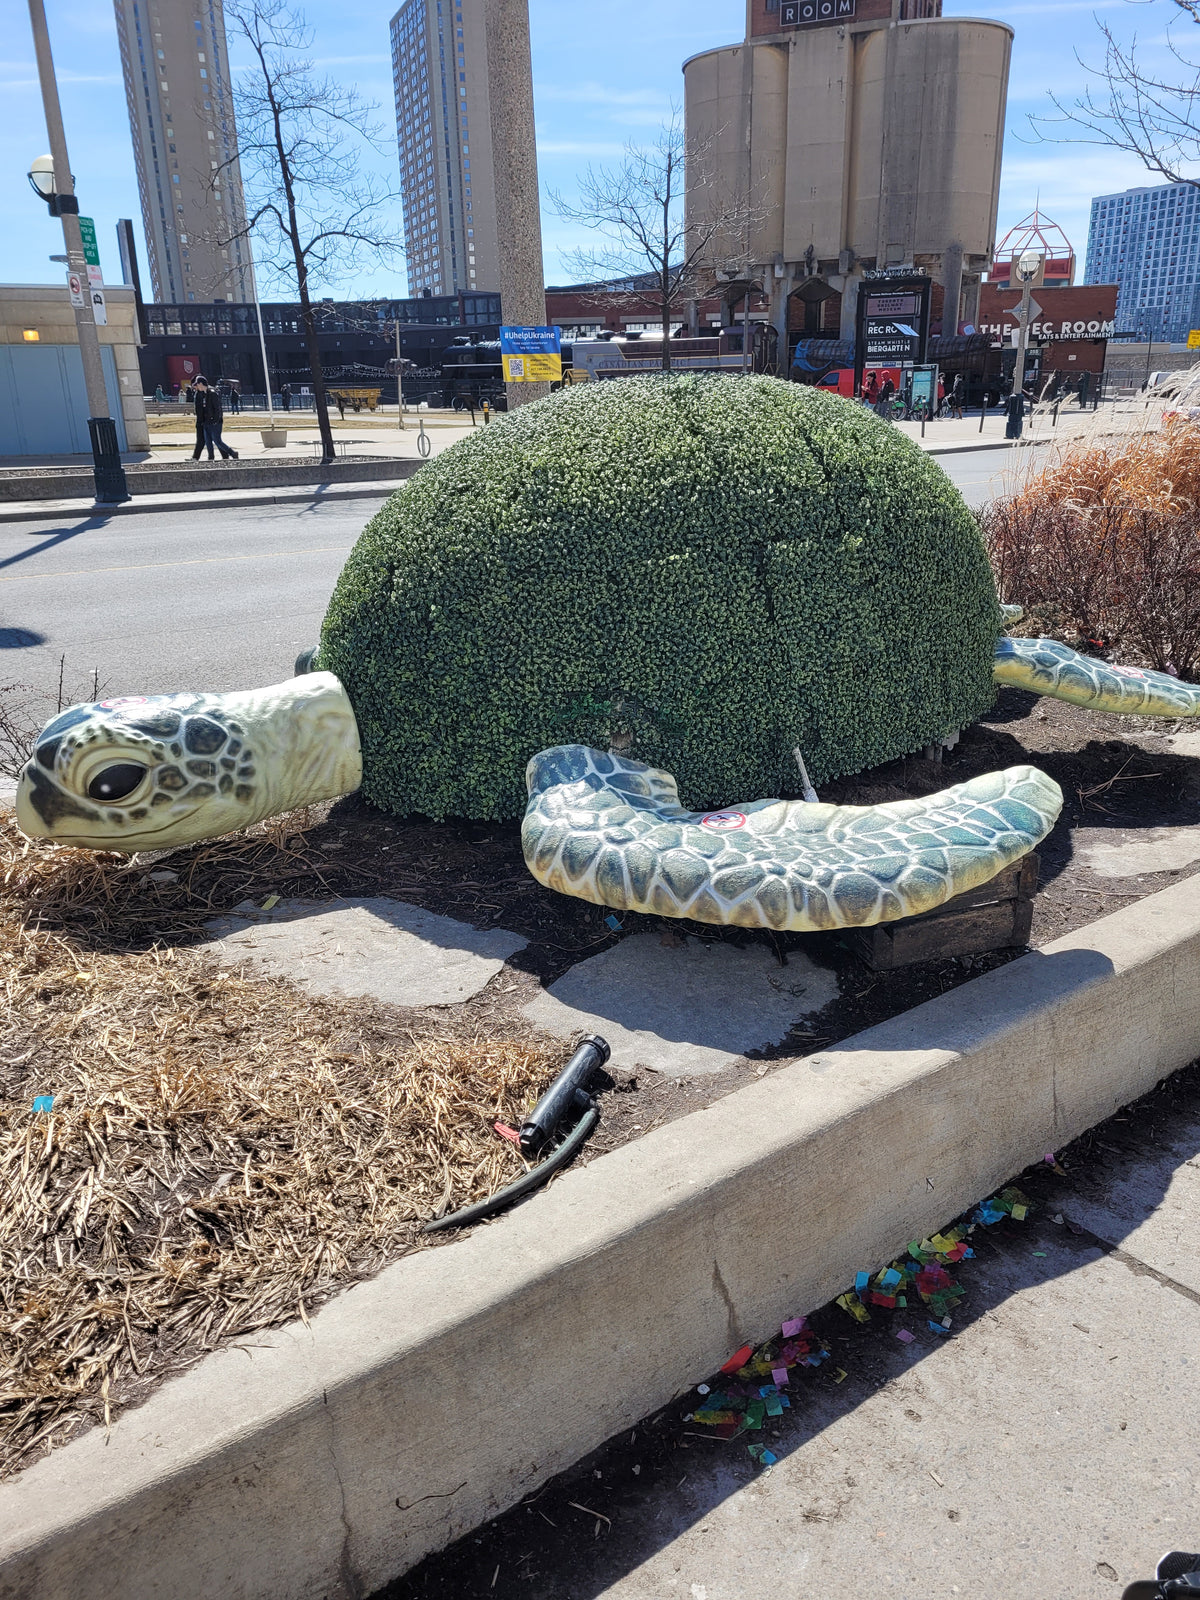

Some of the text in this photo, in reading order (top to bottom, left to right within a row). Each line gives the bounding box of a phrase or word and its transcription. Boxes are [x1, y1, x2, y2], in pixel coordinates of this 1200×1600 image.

[786, 0, 850, 20] ROOM
[868, 326, 884, 334] REC
[980, 324, 1012, 336] THE
[1062, 320, 1115, 334] ROOM
[505, 331, 555, 340] #UhelpUkraine
[868, 344, 911, 353] BIERGARTEN
[599, 360, 643, 369] CANADIAN
